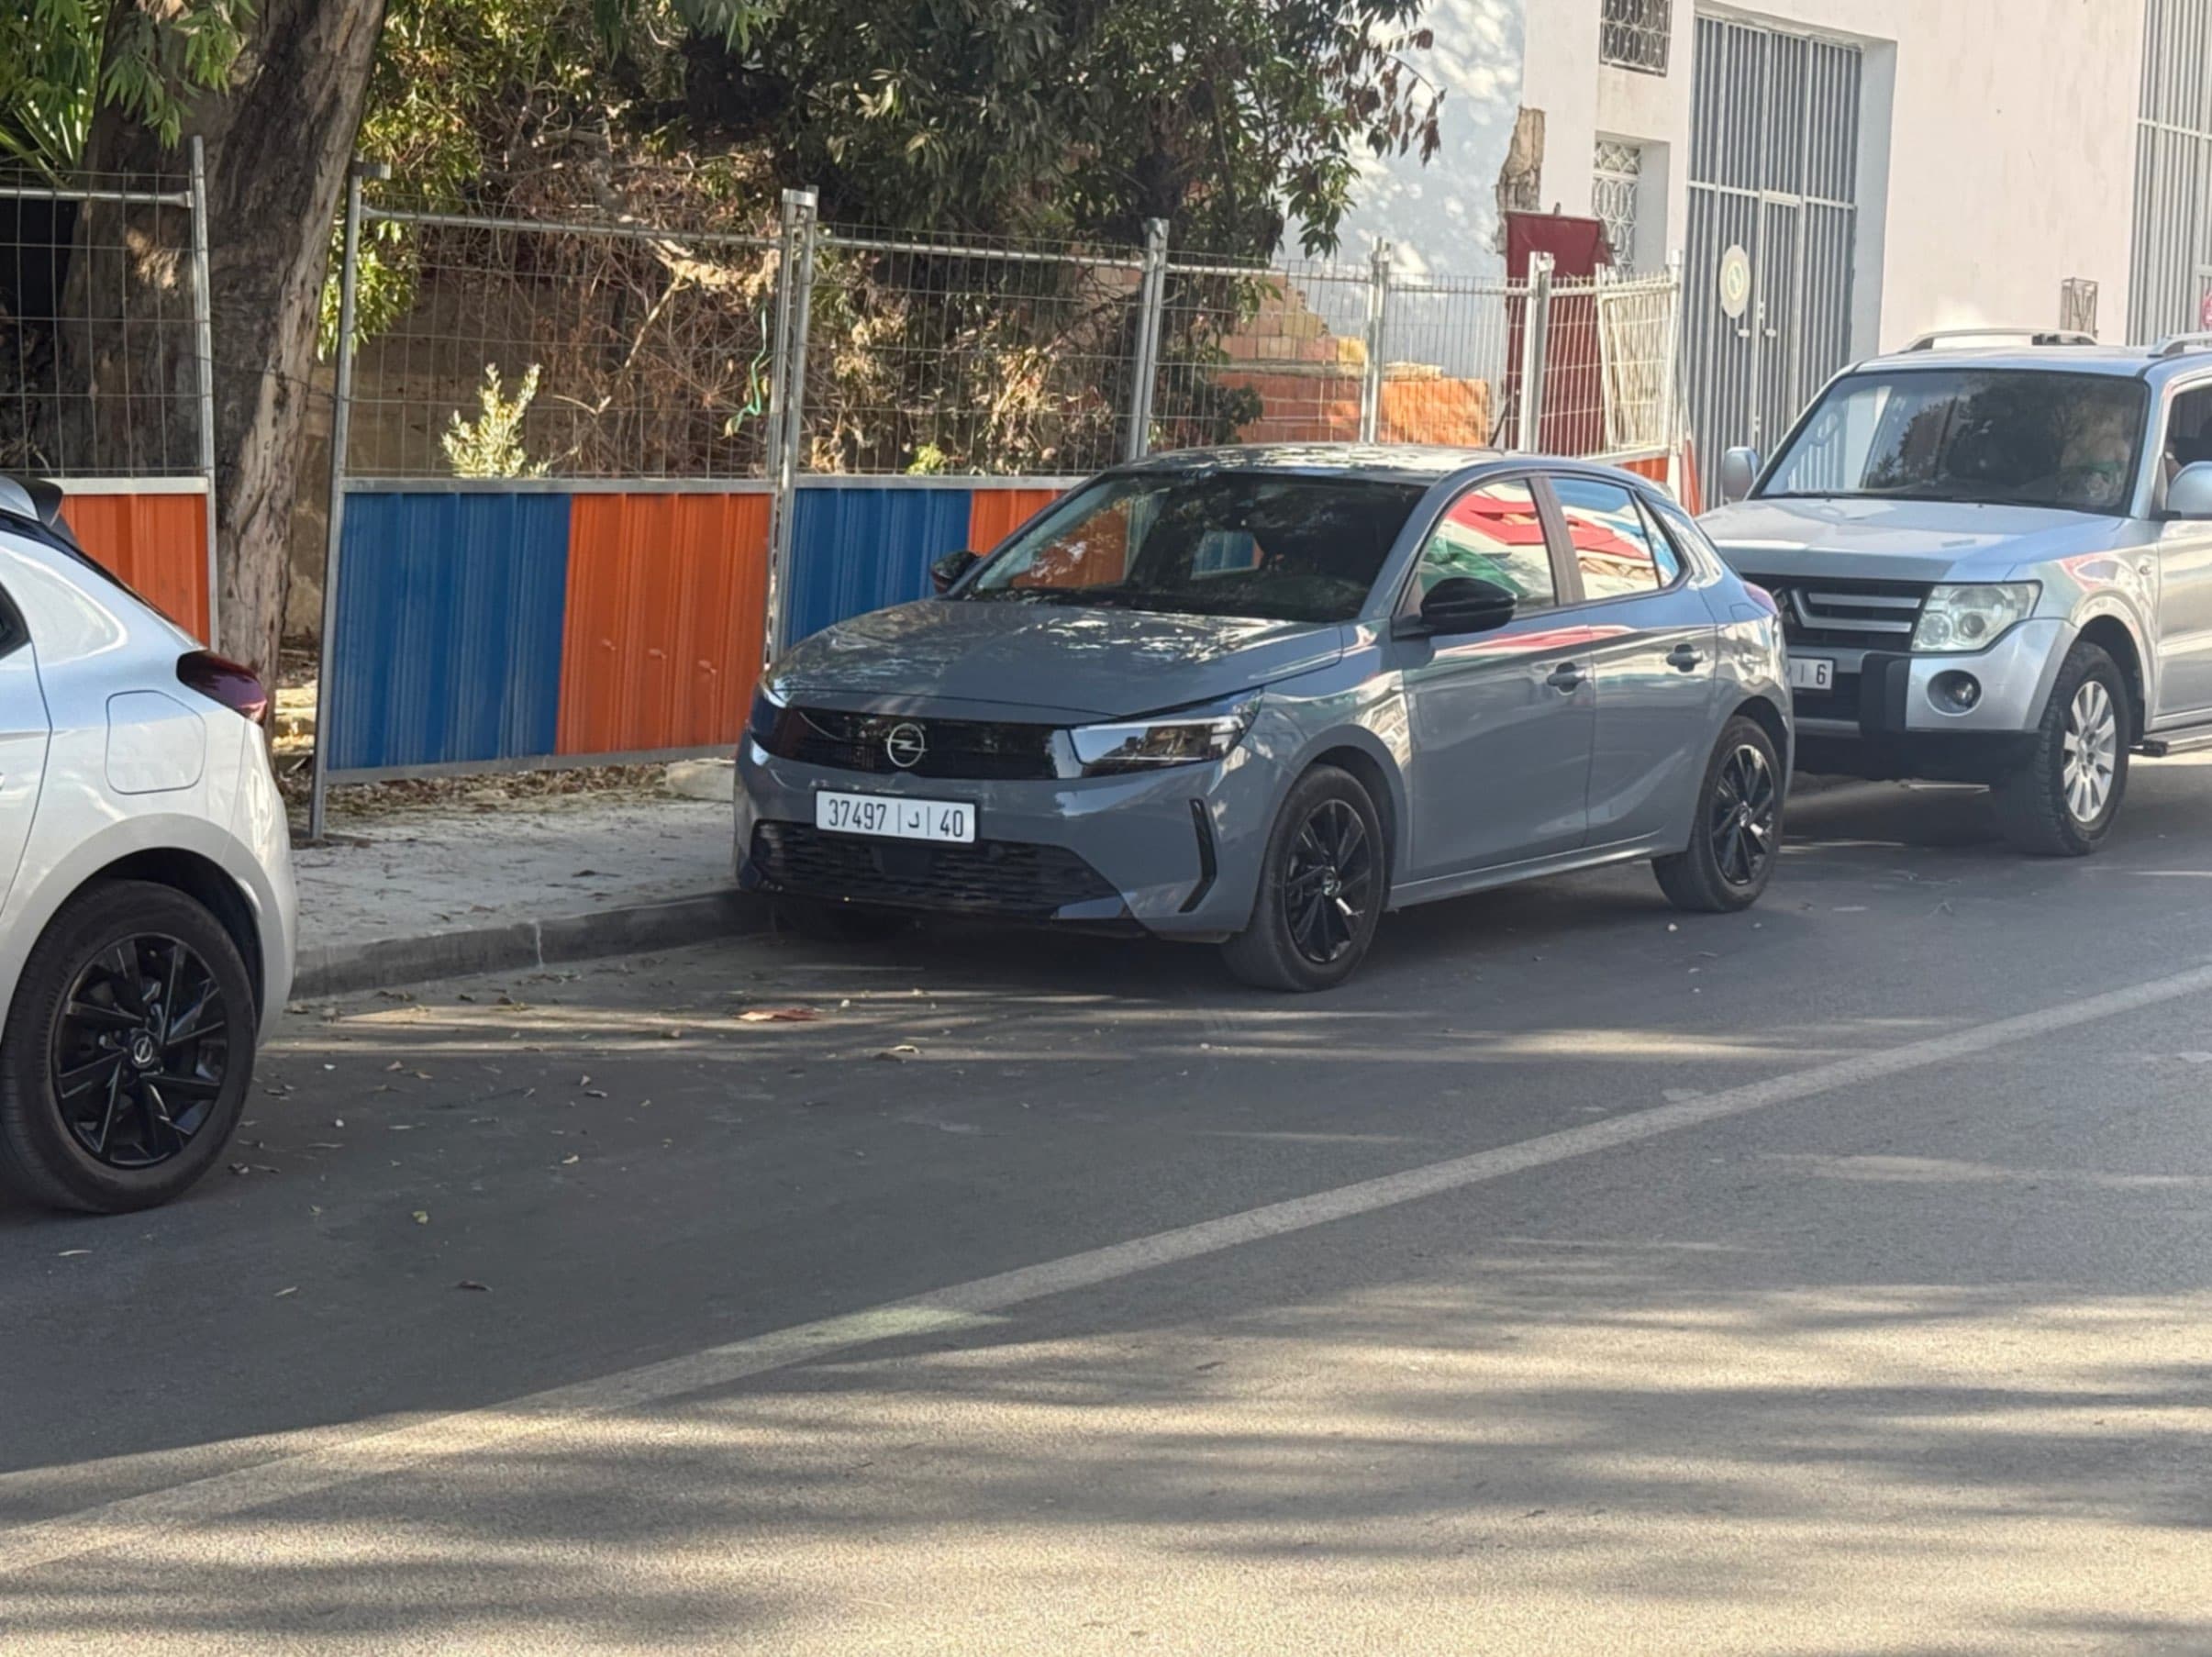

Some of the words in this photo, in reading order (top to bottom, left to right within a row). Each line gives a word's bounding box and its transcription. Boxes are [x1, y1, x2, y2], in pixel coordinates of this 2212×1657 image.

[1817, 663, 1827, 684] 6
[828, 798, 887, 831] 37497
[939, 808, 963, 838] 40
